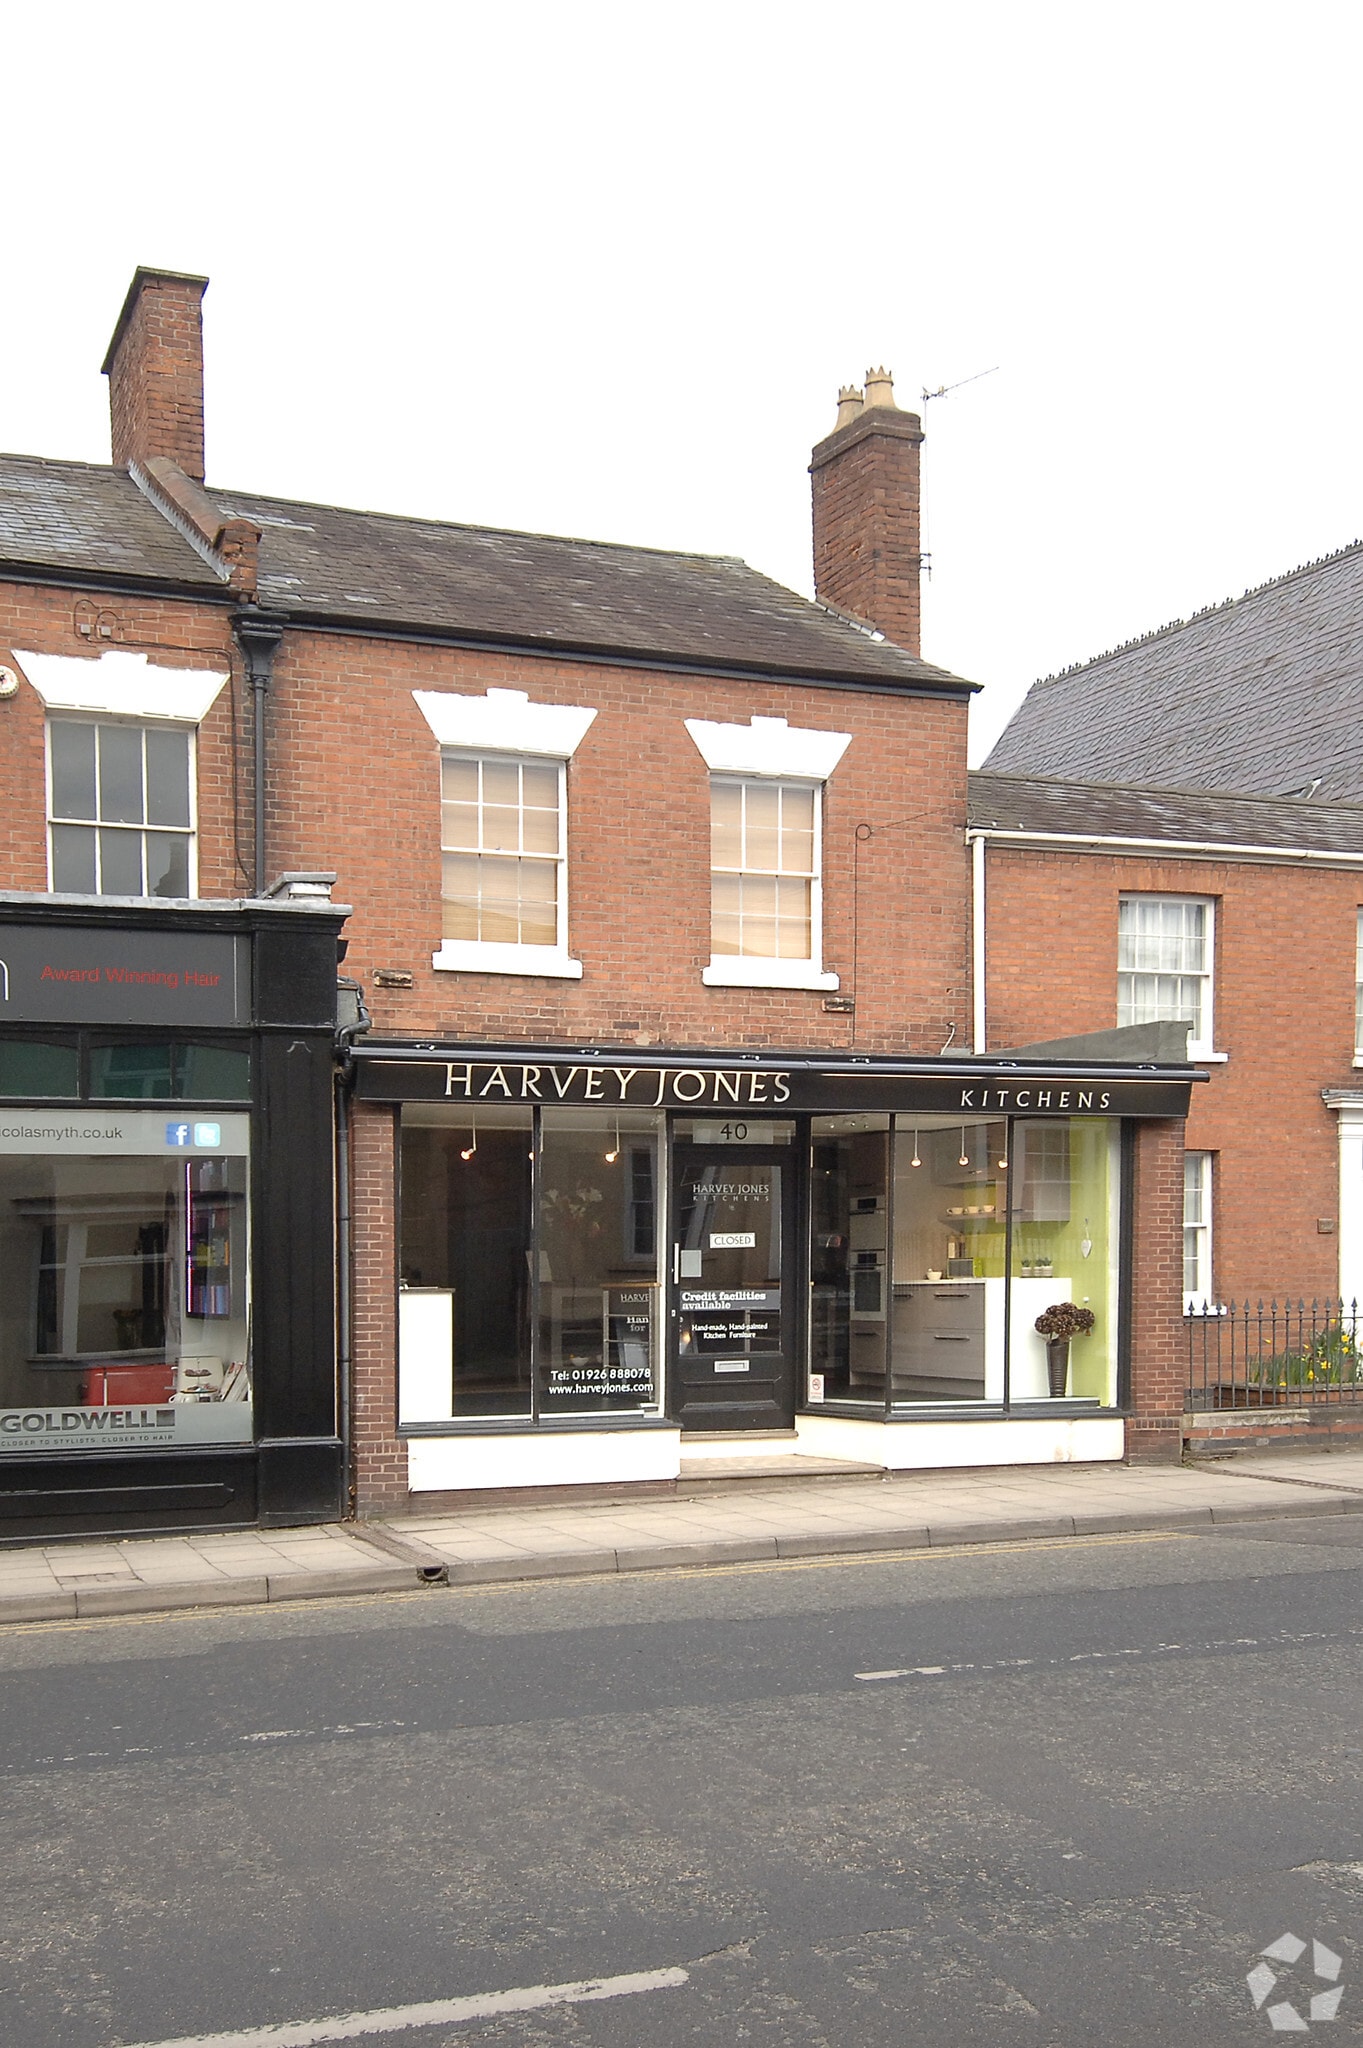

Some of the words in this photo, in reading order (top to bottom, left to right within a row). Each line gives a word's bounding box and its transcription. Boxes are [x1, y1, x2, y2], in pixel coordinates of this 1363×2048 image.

[40, 965, 100, 983] Award
[105, 967, 178, 989] Winning
[184, 970, 220, 986] Hair
[444, 1063, 638, 1100] HARVEY
[653, 1069, 791, 1107] JONES
[961, 1090, 1110, 1109] KITCHENS
[0, 1126, 123, 1141] colasmyth.co.uk
[720, 1123, 748, 1141] 40
[693, 1184, 735, 1194] HARVEY
[738, 1184, 770, 1195] JONES
[714, 1236, 751, 1245] CLOSED
[621, 1293, 649, 1302] HARVE
[682, 1291, 717, 1301] Credit
[719, 1291, 766, 1301] facilities
[682, 1301, 731, 1310] available
[627, 1316, 649, 1324] Han
[551, 1370, 569, 1381] Tel:
[572, 1369, 607, 1380] 01926
[610, 1368, 651, 1379] 888078
[549, 1383, 653, 1395] www.harveyjones.com
[0, 1410, 155, 1433] GOLDWELL
